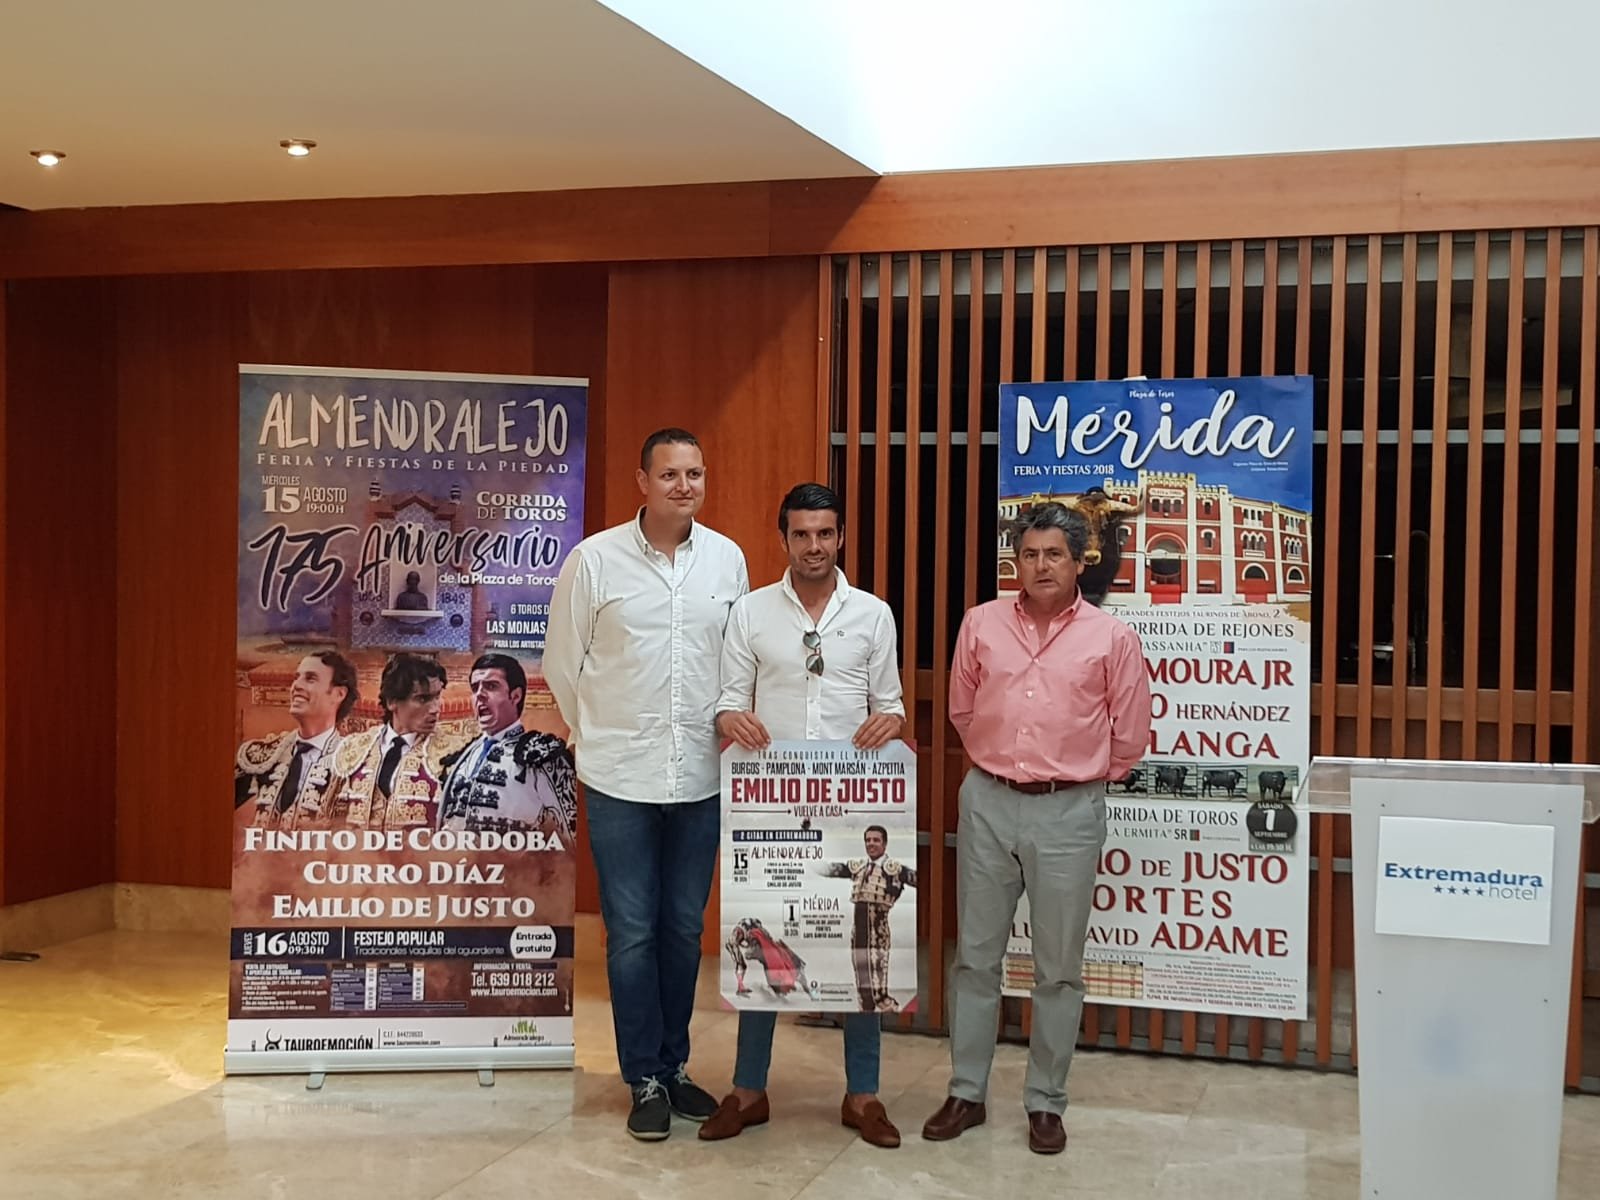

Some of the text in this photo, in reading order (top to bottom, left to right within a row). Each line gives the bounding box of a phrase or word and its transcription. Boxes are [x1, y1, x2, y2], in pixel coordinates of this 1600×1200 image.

[258, 391, 568, 457] ALMENDRALEJO
[1016, 389, 1295, 469] Mérida
[257, 453, 569, 474] FERIA Y FIESTAS DE LA PIEDAD
[1014, 463, 1115, 477] FERIA Y FIESTAS 2018
[262, 486, 347, 513] 15 AGOSTO
[476, 491, 567, 508] CORRIDA
[306, 503, 344, 514] 19:00H
[477, 506, 567, 521] DE TOROS
[250, 522, 559, 613] 175 Aniversario
[439, 572, 559, 586] de la Plaza de Toros
[511, 604, 517, 615] 6
[518, 604, 542, 615] TOROS
[1111, 608, 1118, 616] 2
[1156, 610, 1192, 618] FESTEJOS
[1193, 610, 1228, 618] TAURINOS
[1230, 610, 1240, 618] DE
[1273, 609, 1281, 618] 2
[487, 620, 547, 634] LAS MONJAS
[1127, 621, 1294, 639] ORRIDA DE REJONES
[494, 640, 508, 648] PARA
[509, 641, 520, 649] LOS
[1144, 657, 1294, 690] MOURA JR
[1176, 701, 1291, 723] HERNÁNDEZ
[1149, 729, 1280, 759] LANGA
[758, 751, 879, 760] TRAS CONQUISTAR EL NORTE
[731, 759, 905, 775] BURGOS PAMPLONA MONT MARSÁN AZPEITIA
[731, 778, 905, 804] EMILIO DE JUSTO
[794, 805, 819, 817] VUELVE
[825, 806, 843, 817] CASA
[1106, 806, 1238, 826] ORRIDA DE TOROS
[1263, 809, 1275, 831] 1
[243, 823, 565, 852] FINITO DE CÓRDOBA
[751, 845, 823, 860] ALMENDRALEJO
[734, 853, 748, 869] 15
[1141, 859, 1171, 877] DE
[1181, 851, 1288, 885] JUSTO
[303, 857, 505, 885] CURRO DÍAZ
[1384, 862, 1544, 887] Extremadura
[1489, 885, 1538, 901] hotel
[272, 894, 536, 923] EMILIO DE JUSTO
[803, 893, 840, 911] MÉRIDA
[1092, 884, 1233, 919] ORTES
[789, 905, 795, 921] 1
[254, 932, 288, 956] 16
[289, 931, 329, 945] AGOSTO
[354, 931, 445, 946] FESTEJO POPULAR
[516, 932, 552, 941] Entrada
[1086, 926, 1139, 946] AVID
[1150, 921, 1289, 958] ADAME
[288, 945, 324, 955] 09:30H
[354, 946, 408, 955] Tradicionales
[409, 946, 441, 956] vaquillas
[443, 946, 456, 955] del
[516, 945, 552, 954] gratuita
[471, 972, 555, 986] Tel. 639 018 212
[470, 986, 558, 997] www.tauroemocion.com
[284, 1035, 373, 1051] TAUROEMOCIÓN
